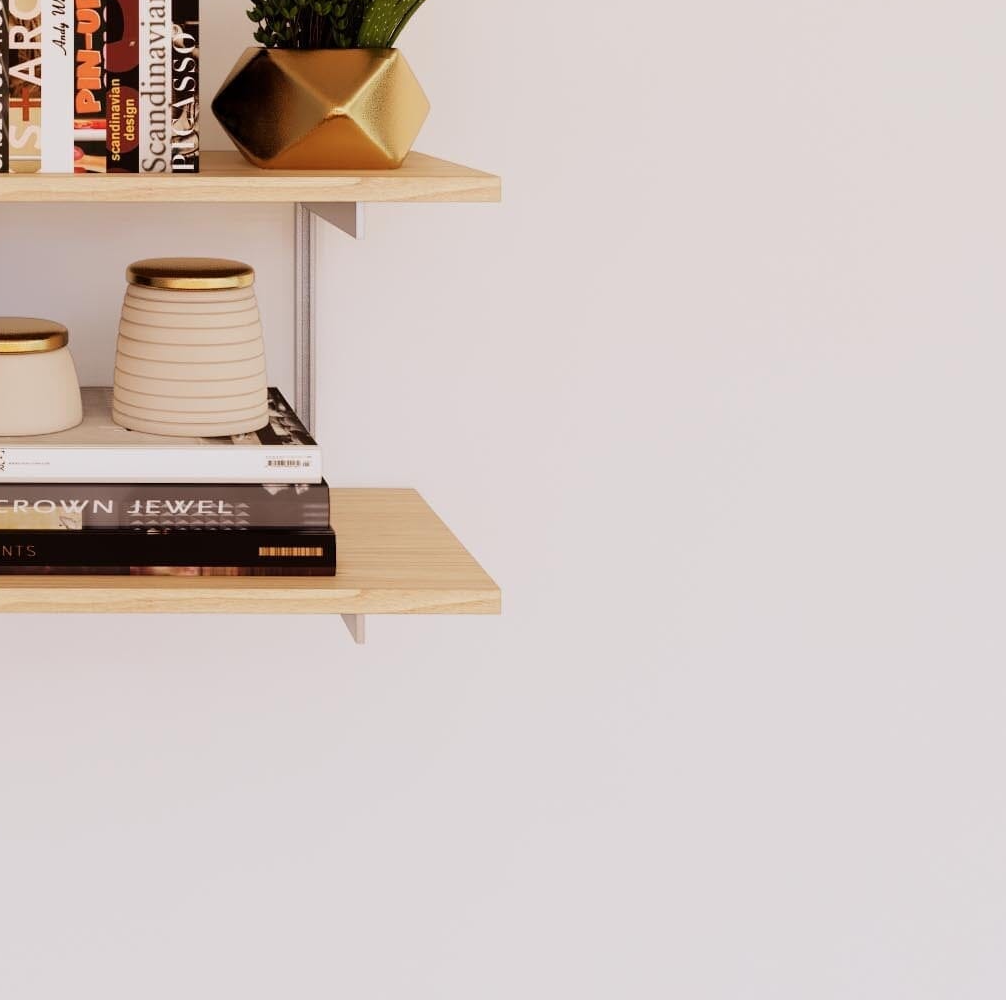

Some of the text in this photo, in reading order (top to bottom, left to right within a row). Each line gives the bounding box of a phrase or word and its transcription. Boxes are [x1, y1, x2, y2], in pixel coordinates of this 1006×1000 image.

[51, 21, 68, 56] Andy
[111, 78, 121, 161] scandinavian
[125, 98, 138, 141] design
[171, 33, 195, 170] PICASSO
[127, 500, 233, 514] JEWEL
